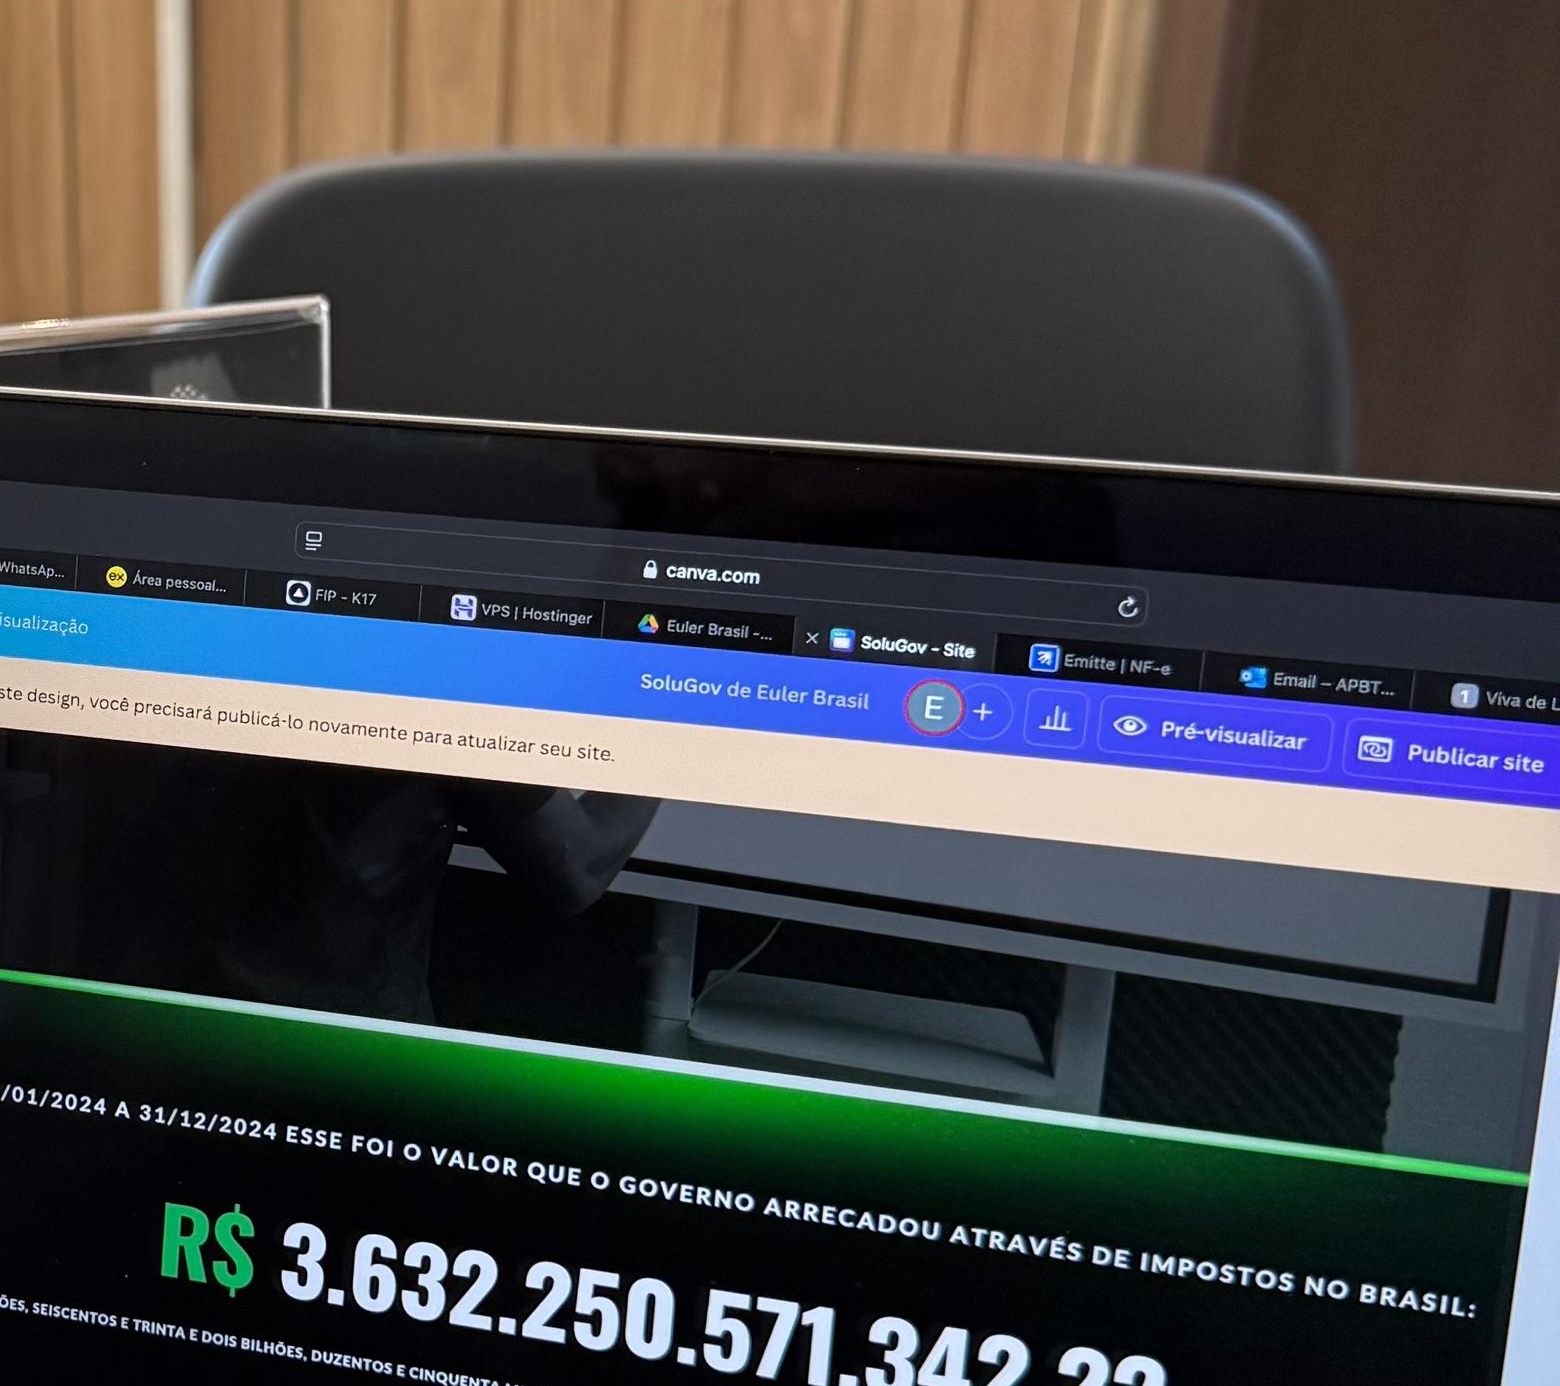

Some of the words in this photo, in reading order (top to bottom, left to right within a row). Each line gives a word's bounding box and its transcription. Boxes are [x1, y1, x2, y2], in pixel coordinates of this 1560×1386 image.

[108, 571, 125, 582] ex
[132, 568, 162, 588] Área
[665, 564, 761, 586] canva.com
[315, 587, 337, 603] FIP
[351, 591, 377, 607] K17
[481, 602, 511, 618] VPS
[522, 606, 593, 627] Hostinger
[667, 618, 705, 636] Euler
[707, 622, 750, 640] Brasil
[860, 634, 929, 656] SoluGov
[942, 641, 977, 660] Site
[1063, 653, 1117, 672] Emitte
[1129, 658, 1172, 677] NF-e
[640, 672, 723, 697] SoluGov
[726, 680, 752, 700] de
[756, 683, 809, 705] Euler
[812, 688, 869, 711] Brasil
[1273, 671, 1317, 690] Email
[925, 695, 944, 719] E
[1486, 691, 1521, 708] Viva
[1525, 695, 1547, 710] de
[27, 688, 85, 711] design,
[89, 696, 130, 713] você
[133, 701, 212, 722] precisará
[217, 709, 304, 731] publicá-lo
[308, 719, 408, 742] novamente
[412, 729, 453, 747] para
[457, 733, 536, 754] atualizar
[539, 742, 572, 759] seu
[576, 743, 615, 763] site.
[1161, 720, 1308, 752] Pré-visualizar
[1407, 743, 1500, 770] Publicar
[1502, 752, 1545, 775] site
[114, 1100, 131, 1120] A
[139, 1103, 277, 1141] 31/12/2024
[285, 1124, 343, 1151] ESSE
[351, 1133, 394, 1158] FOI
[403, 1142, 422, 1163] O
[430, 1145, 518, 1178] VALOR
[527, 1160, 582, 1188] QUE
[590, 1170, 610, 1191] O
[618, 1174, 755, 1213] GOVERNO
[762, 1196, 942, 1242] ARRECADOU
[948, 1224, 1083, 1263] ATRAVÉS
[1091, 1244, 1131, 1271] DE
[1139, 1251, 1295, 1293] IMPOSTOS
[1304, 1275, 1350, 1301] NO
[1359, 1282, 1476, 1319] BRASIL:
[160, 1200, 255, 1299] R$
[32, 1301, 118, 1328] SEISCENTOS
[120, 1315, 130, 1331] E
[132, 1317, 186, 1340] TRINTA
[189, 1327, 199, 1343] E
[201, 1329, 238, 1349] DOIS
[240, 1336, 308, 1363] BILHÕES,
[310, 1348, 393, 1376] DUZENTOS
[396, 1363, 406, 1379] E
